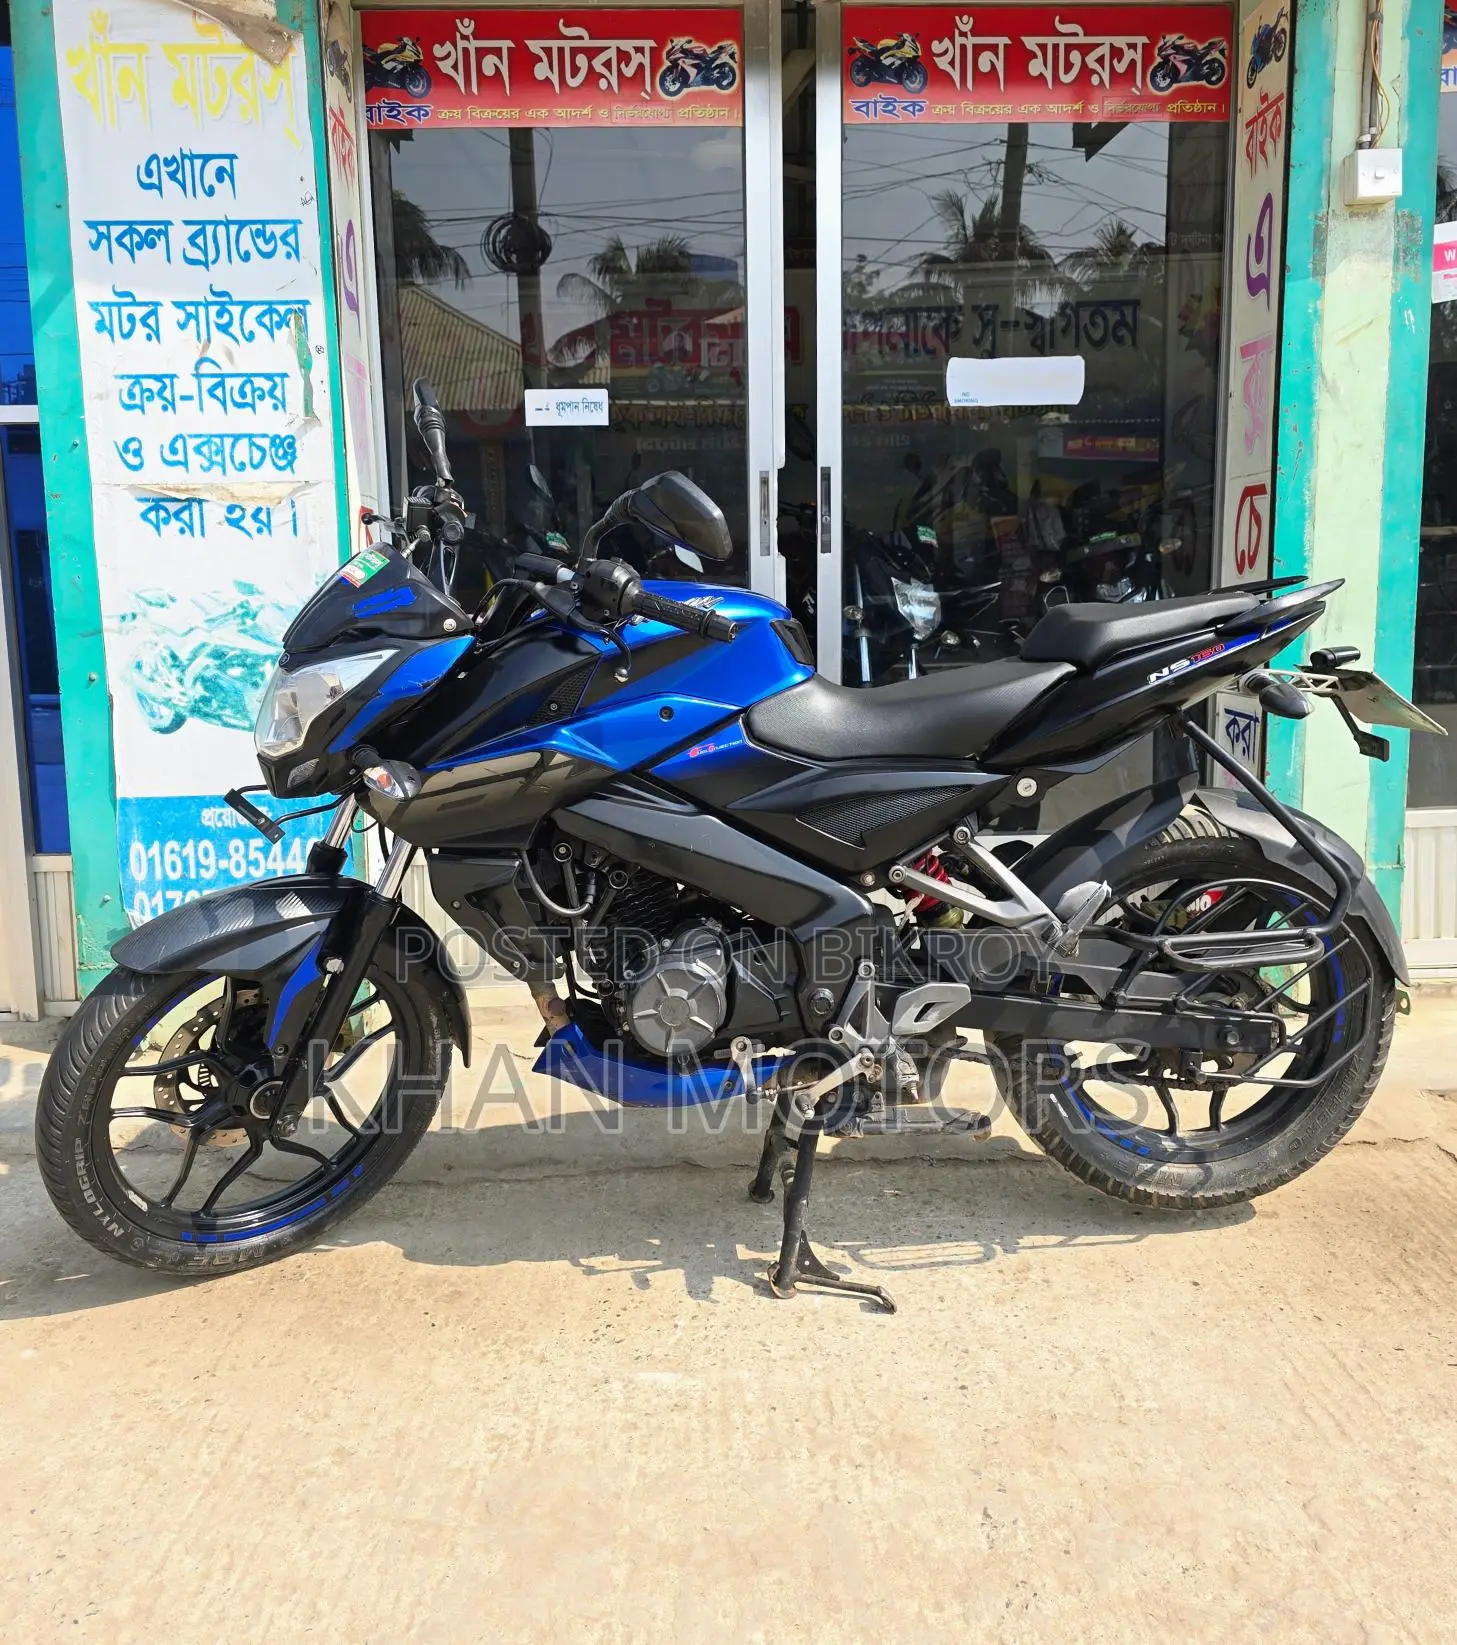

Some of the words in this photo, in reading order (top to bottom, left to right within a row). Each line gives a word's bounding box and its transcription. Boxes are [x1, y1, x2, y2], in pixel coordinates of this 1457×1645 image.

[432, 17, 516, 97] খাঁন
[524, 18, 658, 101] মটরস্
[930, 14, 1013, 92] খাঁন
[1020, 15, 1150, 96] মটরস্
[365, 99, 433, 126] বাইক
[437, 106, 462, 120] ক্রয়
[467, 104, 520, 121] বিক্রয়ের
[525, 107, 549, 120] এক
[554, 104, 592, 120] আদর্শ
[599, 108, 609, 120] ও
[850, 97, 928, 120] বাইক
[931, 103, 955, 116] ক্রয়
[961, 101, 1012, 117] বিক্রয়ের
[1018, 103, 1041, 115] এক
[1046, 101, 1084, 115] আদর্শ
[1088, 104, 1099, 115] ও
[1245, 85, 1285, 180] বাইক
[137, 147, 239, 200] এখানে
[84, 218, 175, 266] সকল
[182, 214, 303, 272] ব্র্যান্ডের
[87, 285, 163, 345] মটর
[171, 284, 312, 347] সাইকেল
[115, 357, 290, 416] ক্রয়-বিক্রয়
[113, 436, 145, 472] ও
[160, 433, 298, 477] এক্সচেঞ্জ
[135, 497, 211, 538] করা
[1224, 708, 1260, 764] করা
[74, 1137, 125, 1238] NYLOGRIP
